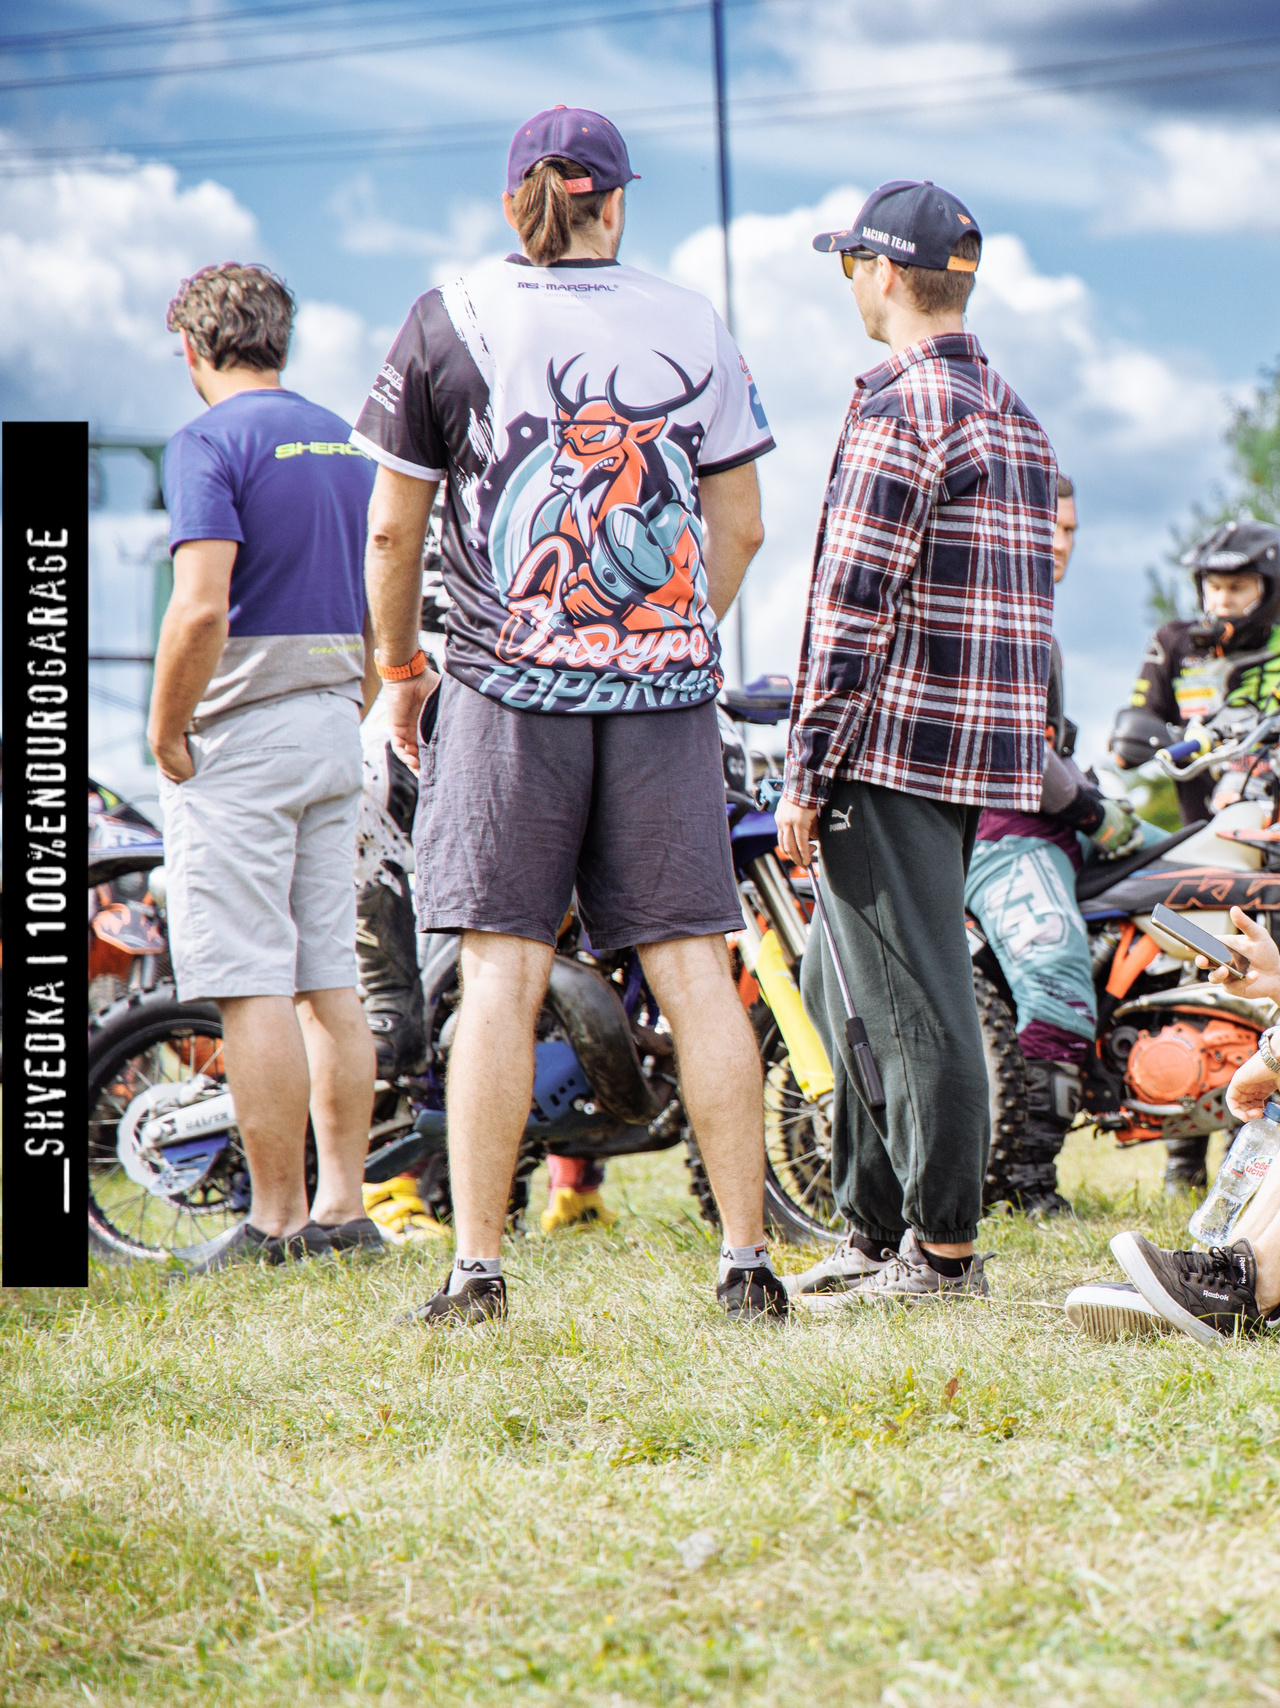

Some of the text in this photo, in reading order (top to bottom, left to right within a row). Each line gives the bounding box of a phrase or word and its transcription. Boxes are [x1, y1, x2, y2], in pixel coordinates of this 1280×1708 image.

[862, 226, 917, 254] RACING TEAM
[274, 441, 371, 460] SHERC
[829, 822, 847, 832] PUMA
[456, 1259, 488, 1272] ILA
[1202, 1289, 1230, 1301] Reebok
